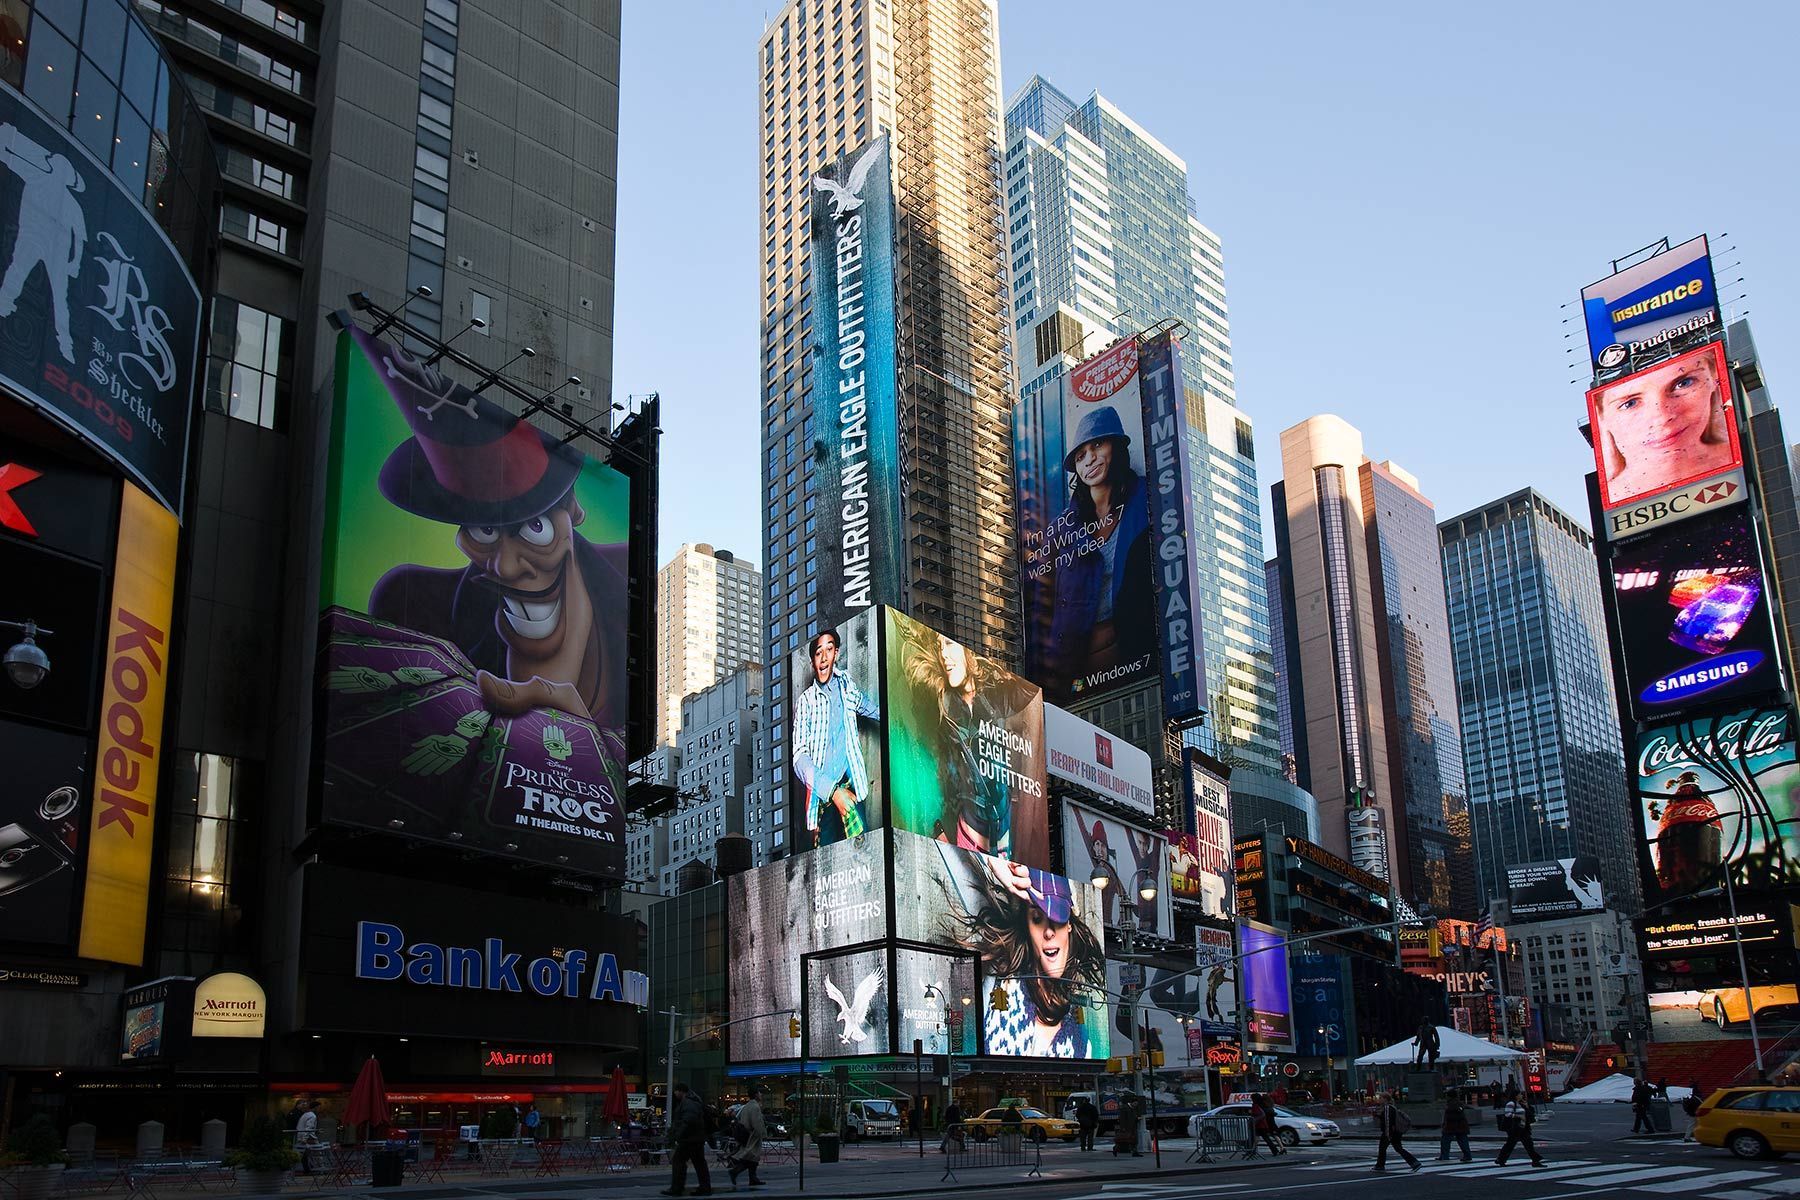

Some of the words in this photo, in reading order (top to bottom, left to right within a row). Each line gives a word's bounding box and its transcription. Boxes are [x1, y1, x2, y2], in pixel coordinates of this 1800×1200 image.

[836, 213, 865, 370] OUTFITTERS
[1629, 310, 1715, 355] Prudential
[44, 363, 133, 442] 2009
[88, 357, 164, 439] Sheckler
[840, 371, 868, 460] EAGLE
[1147, 364, 1176, 495] TIMES
[1027, 540, 1051, 563] and
[1053, 513, 1114, 550] Windows
[1115, 503, 1124, 521] 7
[1046, 524, 1054, 537] a
[1057, 510, 1075, 532] PC
[1610, 493, 1691, 535] HSBC
[843, 463, 871, 608] AMERICAN
[1028, 560, 1052, 580] was
[1054, 549, 1075, 568] my
[1077, 535, 1107, 558] idea.
[1158, 508, 1191, 676] SQUARE
[1086, 660, 1142, 688] Windows
[1656, 660, 1749, 693] SAMSUNG
[1172, 690, 1191, 702] NYC
[98, 607, 164, 839] Kodak
[978, 719, 1032, 758] AMERICAN
[545, 758, 573, 773] Disney
[978, 738, 1011, 767] EAGLE
[503, 761, 615, 805] PRINCESS
[979, 758, 1042, 798] OUTFITTERS
[1050, 748, 1080, 777] READY
[1081, 760, 1097, 783] FOR
[1097, 769, 1130, 798] HOLIDAY
[517, 784, 613, 824] FROG
[1196, 794, 1228, 820] MUSICAL
[1202, 784, 1220, 803] BEST
[515, 814, 528, 825] IN
[530, 817, 582, 835] THEATRES
[1197, 810, 1220, 849] BILLY
[1349, 808, 1384, 880] SHEY'S
[815, 863, 871, 893] AMERICAN
[815, 889, 848, 912] EAGLE
[815, 900, 880, 930] OUTFITTERS
[1697, 917, 1727, 927] french
[1757, 912, 1766, 920] is
[1200, 928, 1231, 949] HEIGHTS
[1647, 940, 1661, 949] the
[1691, 936, 1703, 944] du
[355, 920, 522, 993] Bank
[527, 949, 587, 998] of
[202, 999, 256, 1010] Marriott
[903, 1008, 938, 1021] AMERICAN
[485, 1051, 553, 1066] Marriott
[876, 1063, 907, 1072] EAGLE
